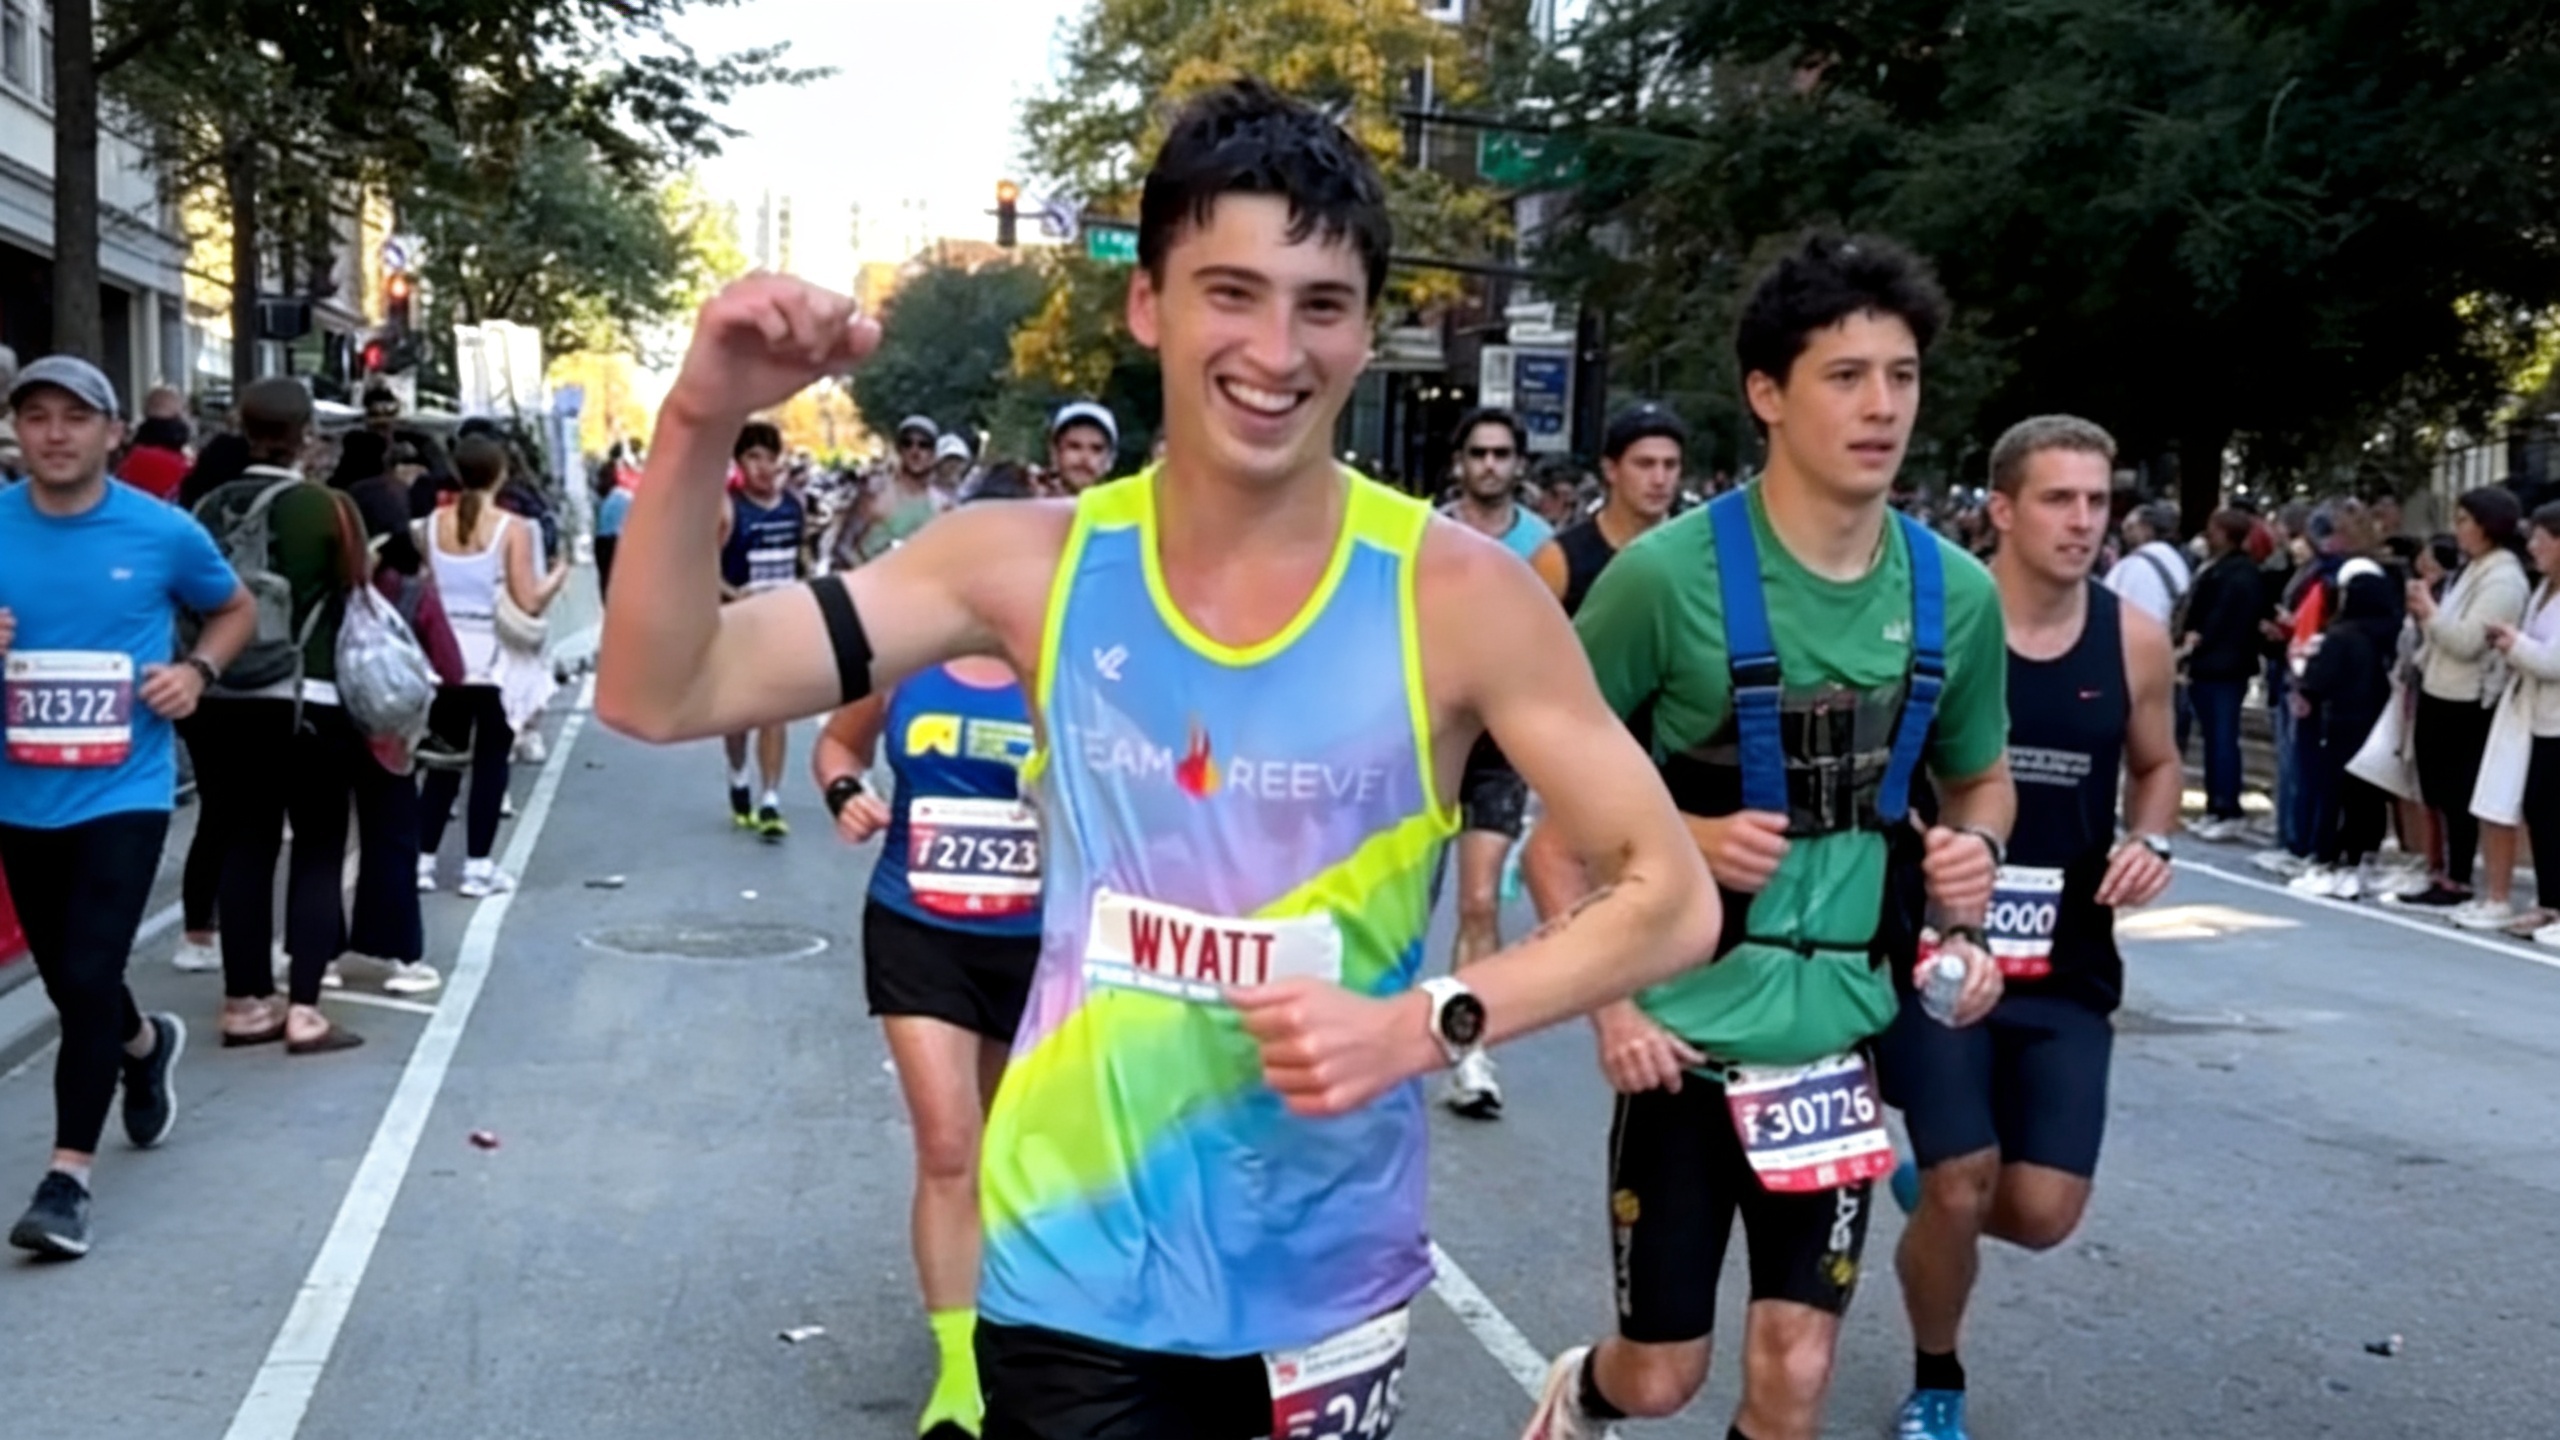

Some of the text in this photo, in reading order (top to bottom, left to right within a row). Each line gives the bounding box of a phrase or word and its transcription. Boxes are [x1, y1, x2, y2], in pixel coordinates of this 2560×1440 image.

[1228, 755, 1385, 801] REEVE
[936, 836, 1037, 872] 27523
[1129, 909, 1275, 985] WYATT
[1765, 1086, 1876, 1141] 30726
